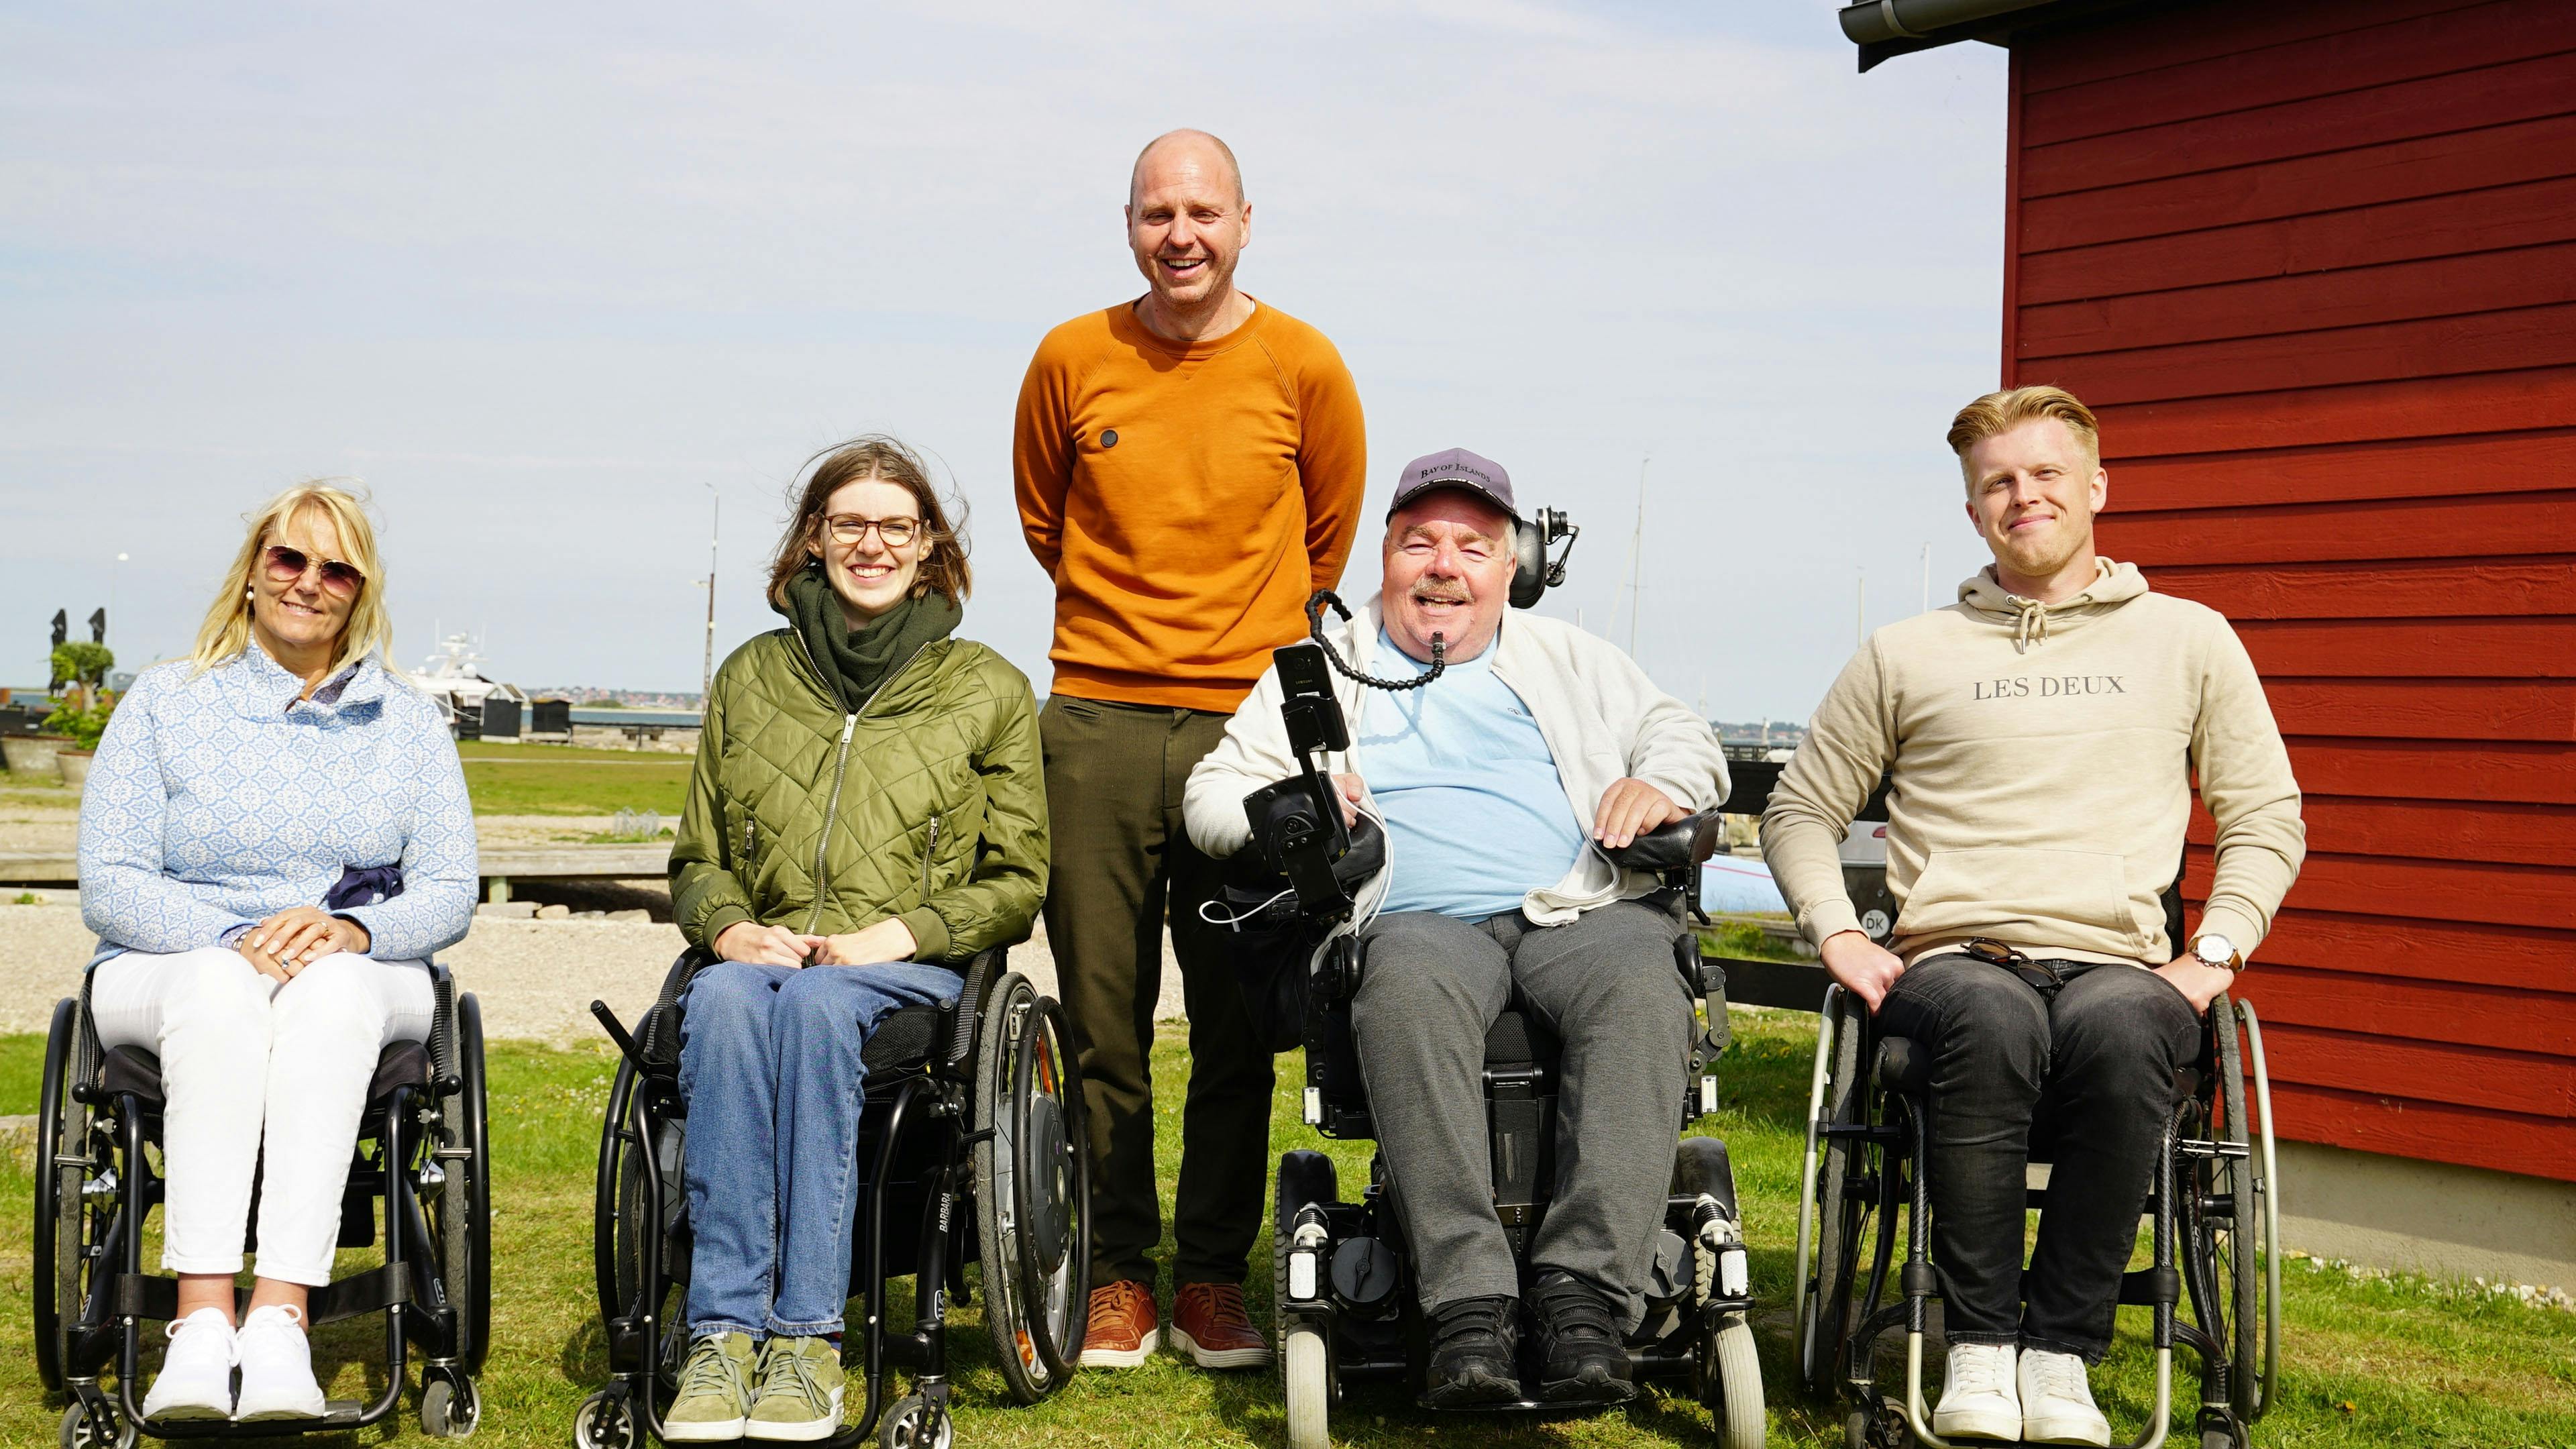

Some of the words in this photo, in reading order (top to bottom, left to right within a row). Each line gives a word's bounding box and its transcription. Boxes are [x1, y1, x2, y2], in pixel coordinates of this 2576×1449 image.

[1421, 466, 1439, 479] BAY
[1455, 463, 1491, 482] ISLANDS
[1973, 677, 2029, 700] LES
[2039, 676, 2126, 697] DEUX
[1866, 918, 1884, 930] DK
[939, 1192, 951, 1233] BARBARA
